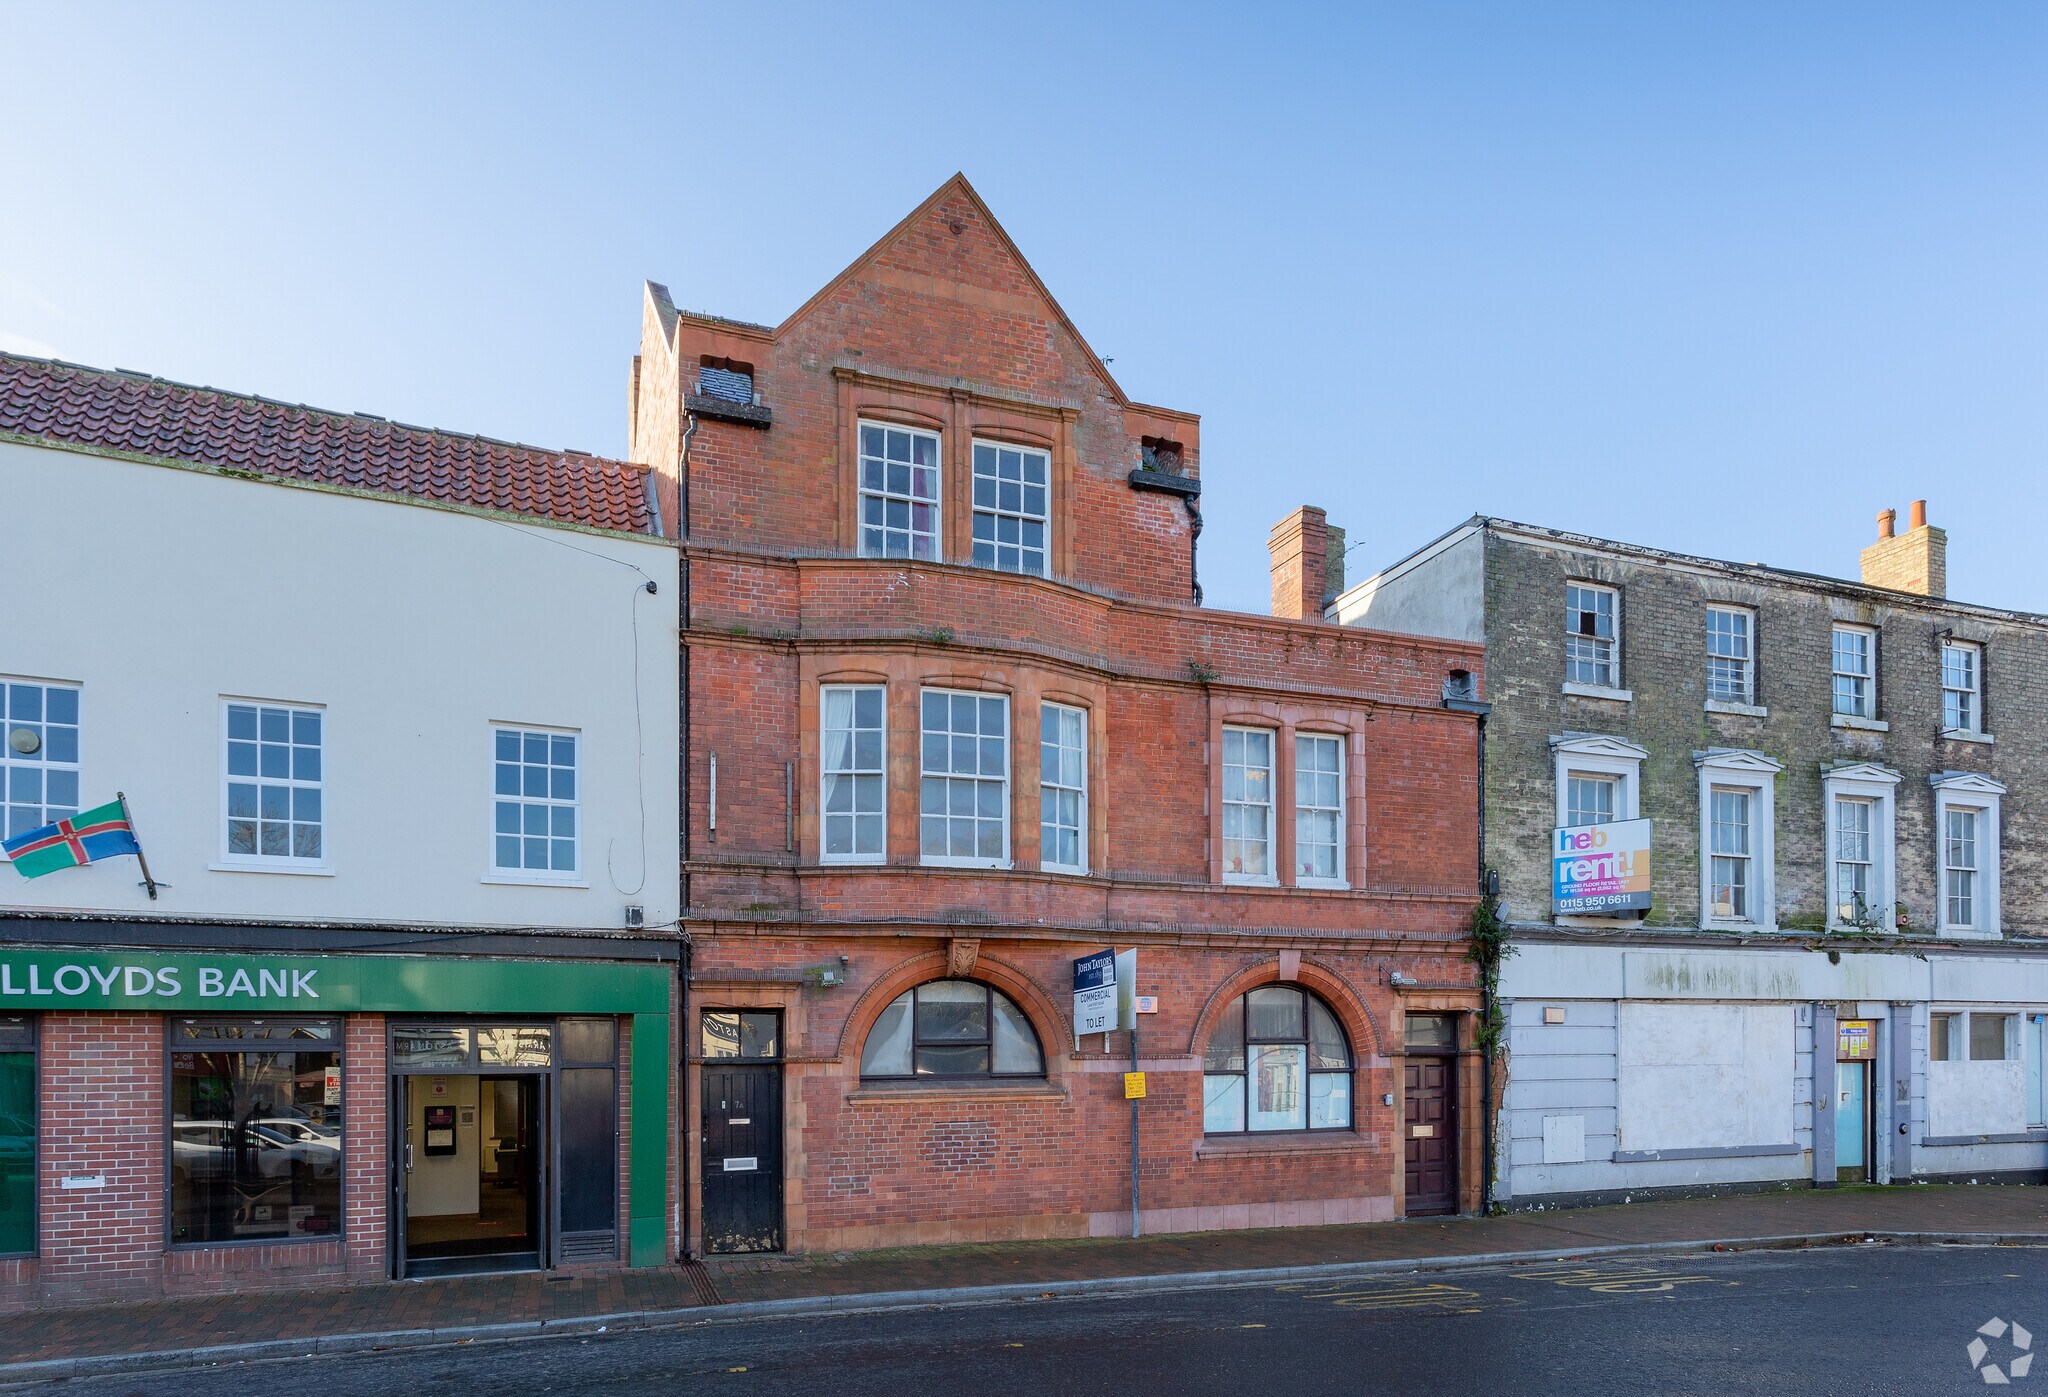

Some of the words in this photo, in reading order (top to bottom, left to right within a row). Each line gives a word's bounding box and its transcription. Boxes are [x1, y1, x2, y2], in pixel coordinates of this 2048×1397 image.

[1561, 826, 1607, 850] heb
[1560, 848, 1635, 883] rent!
[1560, 899, 1583, 909] 0115
[1585, 896, 1606, 906] 950
[1607, 893, 1631, 904] 6611
[1560, 905, 1603, 914] www.heb.co.uk
[1078, 961, 1092, 976] JOHN
[1092, 956, 1112, 969] TAYLORS
[1, 963, 182, 996] LLOYDS
[199, 967, 320, 998] BANK
[1081, 989, 1111, 1003] COMMERCIAL
[1086, 1018, 1093, 1029] TO
[1095, 1016, 1105, 1028] LET
[735, 1101, 744, 1109] 7A
[1508, 1265, 1728, 1294] BUS
